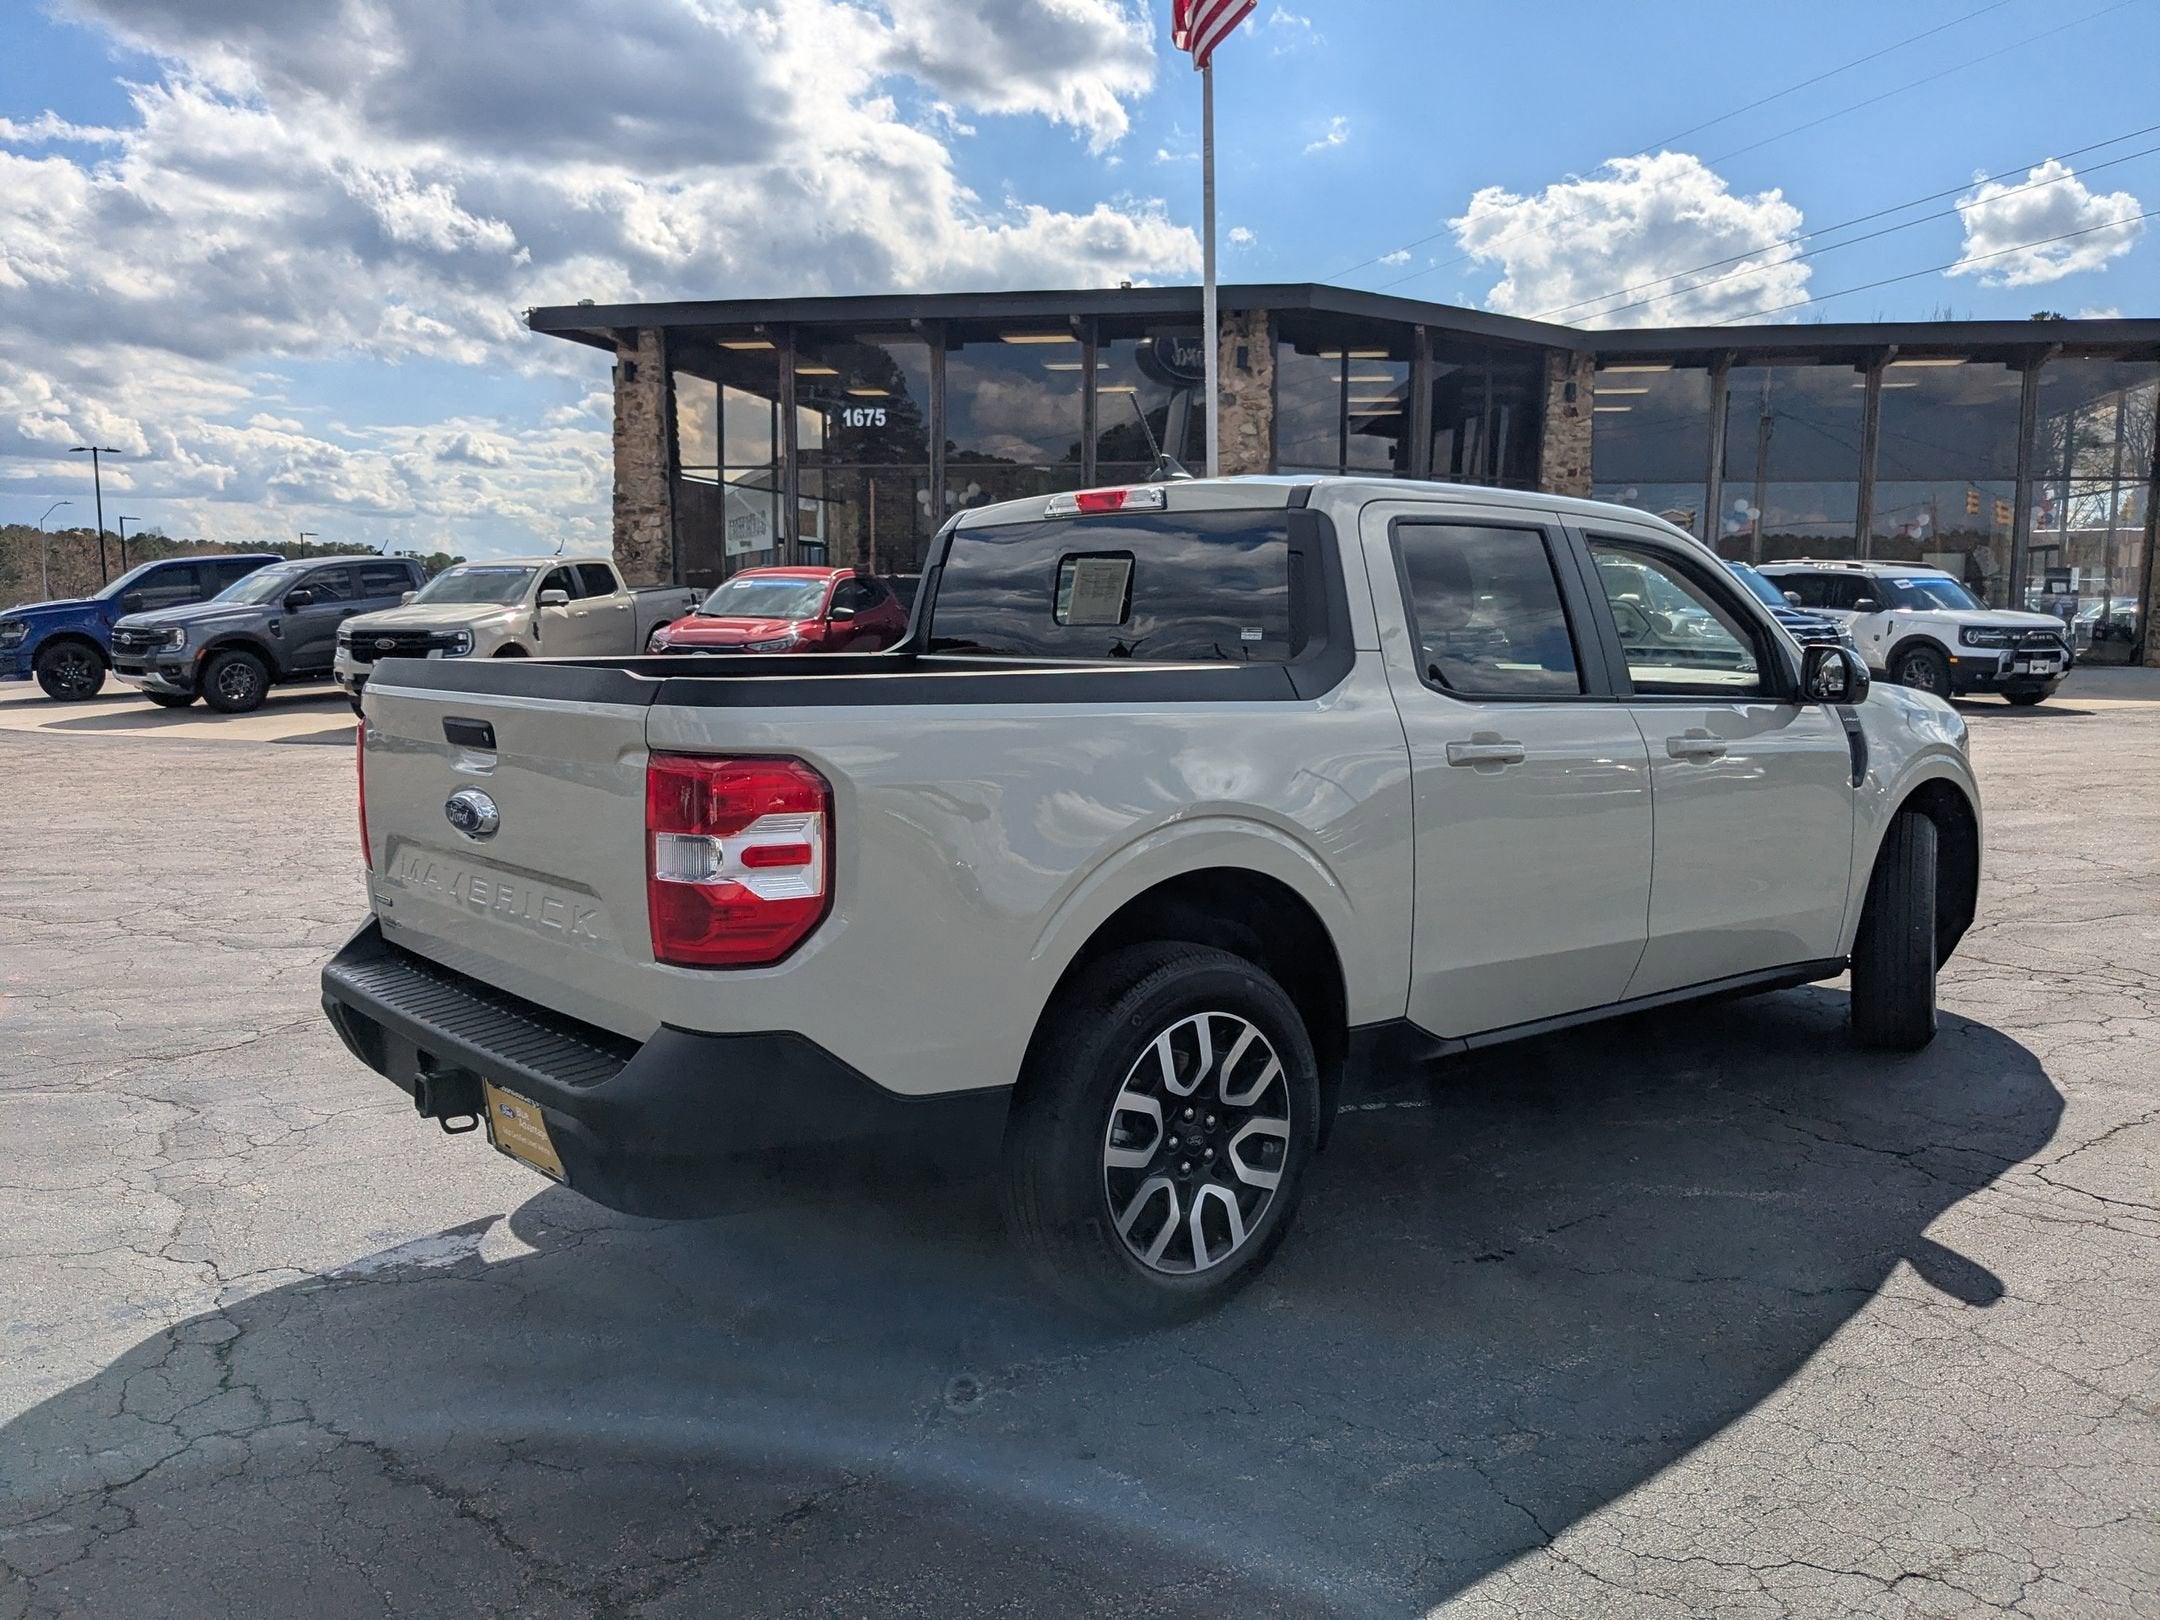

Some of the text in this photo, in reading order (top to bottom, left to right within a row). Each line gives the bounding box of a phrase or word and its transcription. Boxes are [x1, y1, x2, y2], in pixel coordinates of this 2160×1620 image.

[842, 408, 886, 427] 1675
[448, 801, 471, 825] Ford
[400, 854, 598, 939] MAVERICK
